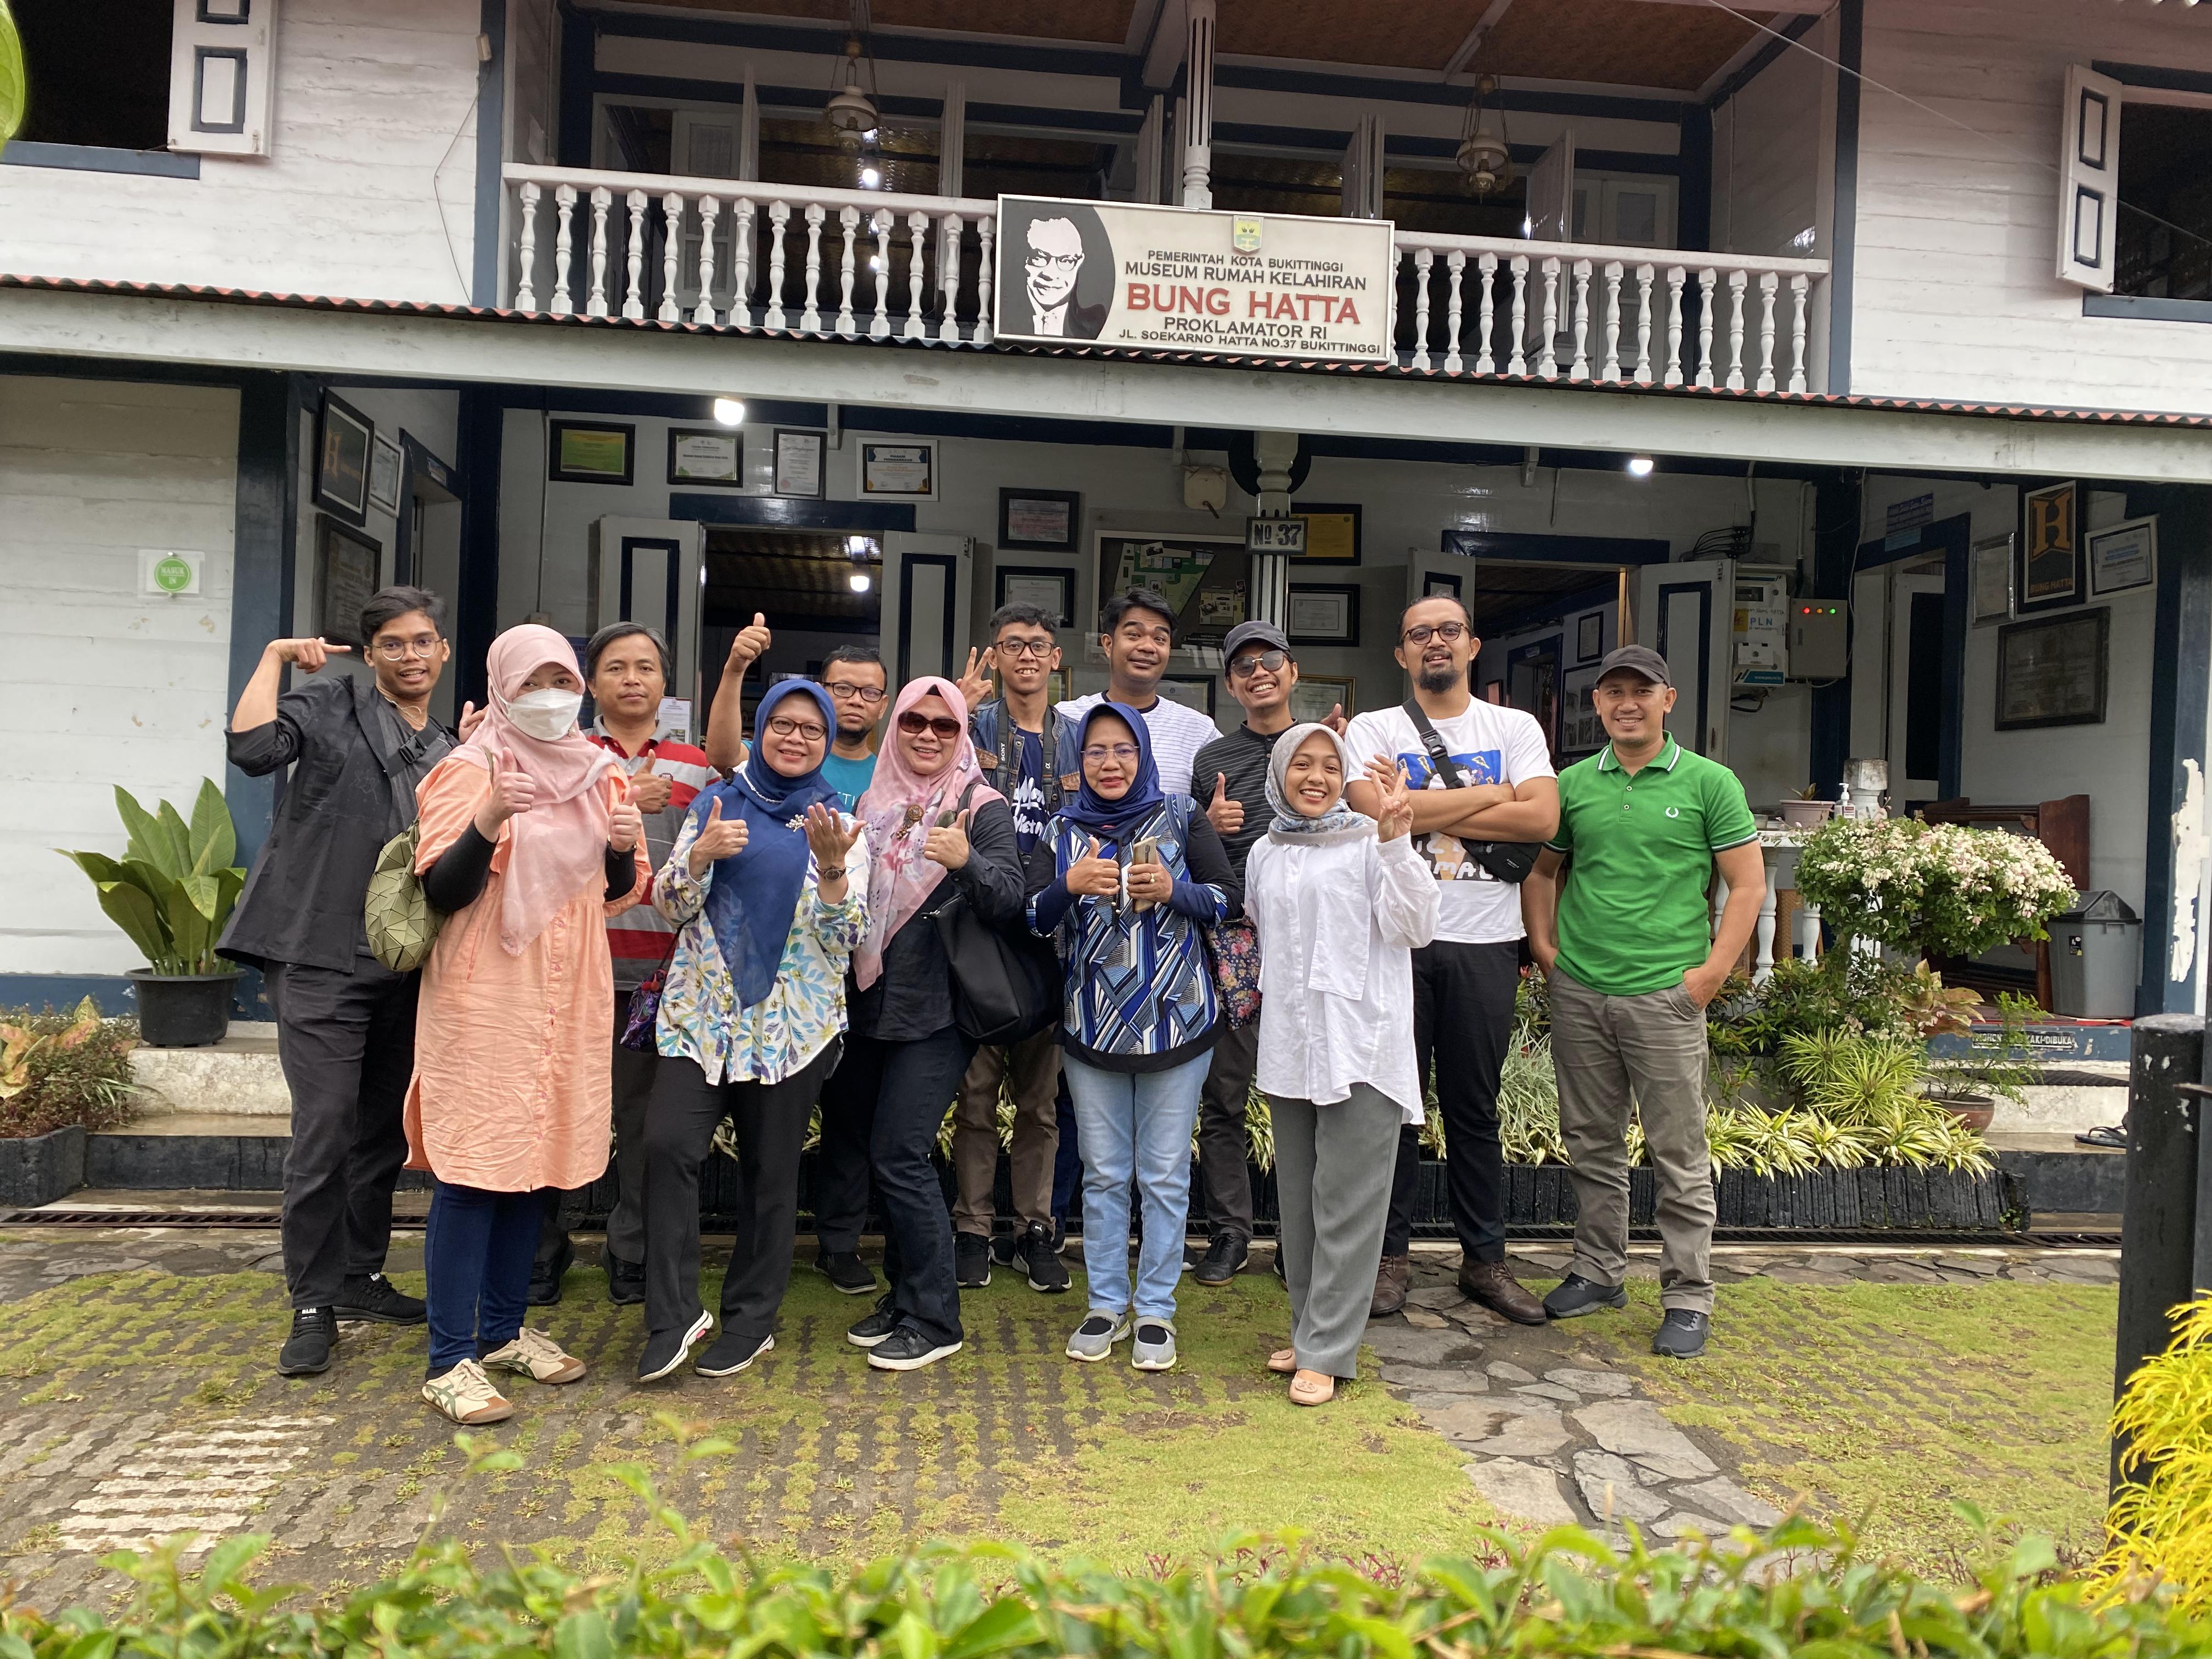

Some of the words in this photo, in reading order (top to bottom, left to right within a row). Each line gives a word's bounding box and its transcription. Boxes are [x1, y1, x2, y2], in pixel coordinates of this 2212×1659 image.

[1148, 250, 1224, 265] PEMERINTAH
[1231, 256, 1262, 267] KOTA
[1268, 258, 1344, 272] BUKITTINGGI
[1125, 261, 1198, 279] MUSEUM
[1204, 266, 1264, 283] RUMAH
[1269, 271, 1367, 290] KELAHIRAN
[1127, 282, 1231, 315] BUNG
[1248, 290, 1361, 324] HATTA
[1164, 317, 1303, 338] PROKLAMATOR
[1310, 325, 1327, 339] RI
[1119, 329, 1137, 338] JL.
[1141, 330, 1214, 343] SOEKARNO
[1218, 335, 1259, 346] HATTA
[1262, 338, 1296, 349] NO.37
[1301, 340, 1380, 354] BUKITTINGGI
[1277, 524, 1302, 546] 37
[1750, 617, 1773, 626] PLN
